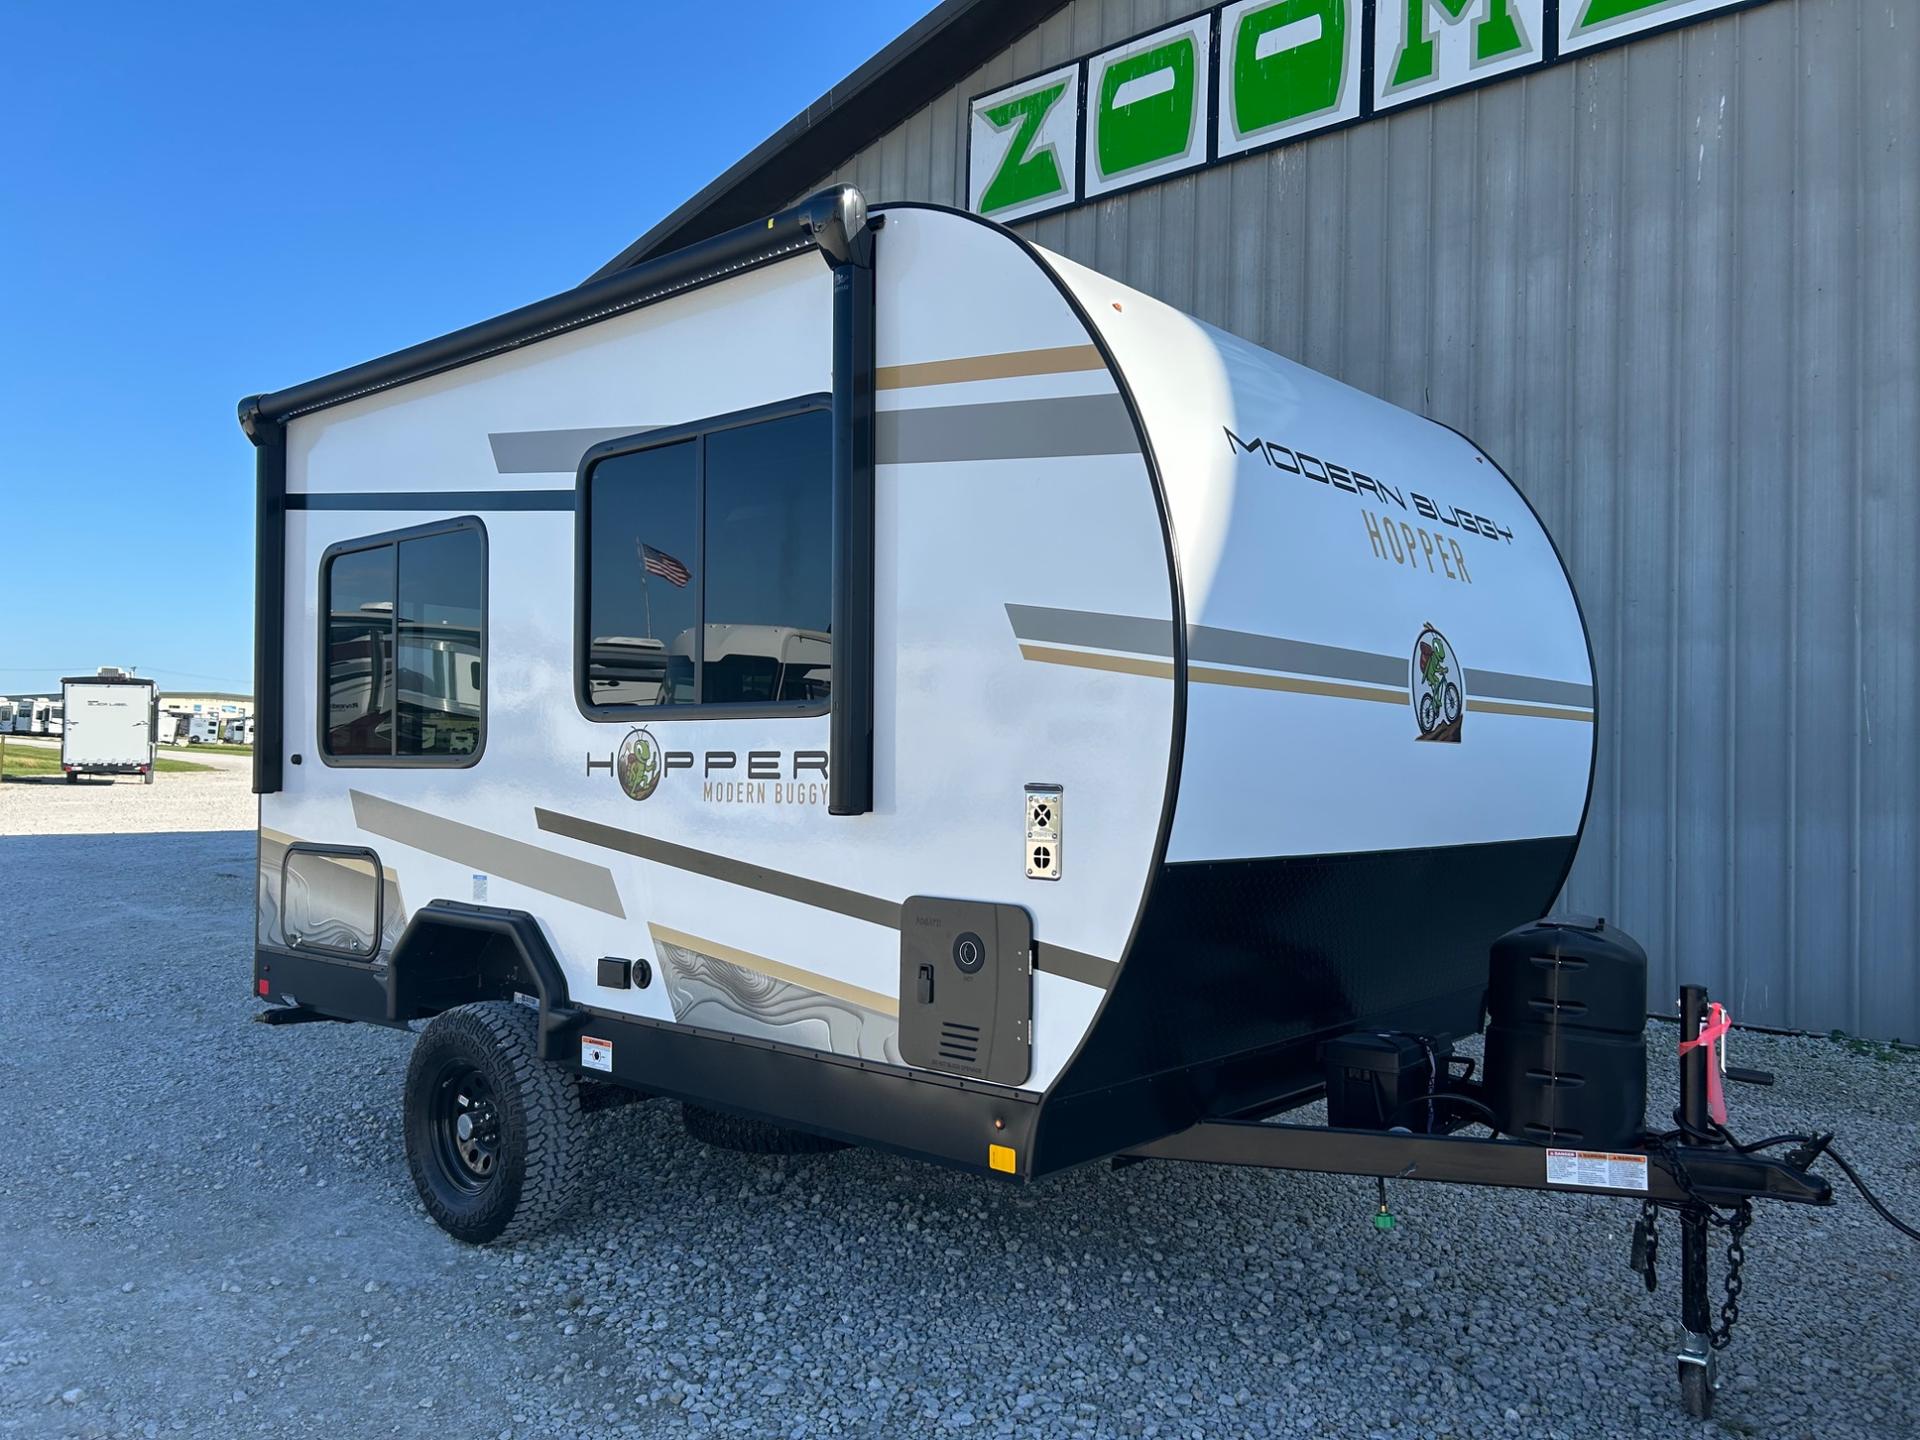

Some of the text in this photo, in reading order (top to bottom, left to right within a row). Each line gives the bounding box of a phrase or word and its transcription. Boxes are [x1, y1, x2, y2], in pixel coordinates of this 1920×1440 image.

[974, 0, 1697, 216] ZOOM
[1223, 425, 1514, 545] MODERN BUGGY
[1361, 508, 1473, 585] HOPPER
[703, 782, 829, 805] MODERN BUGGY
